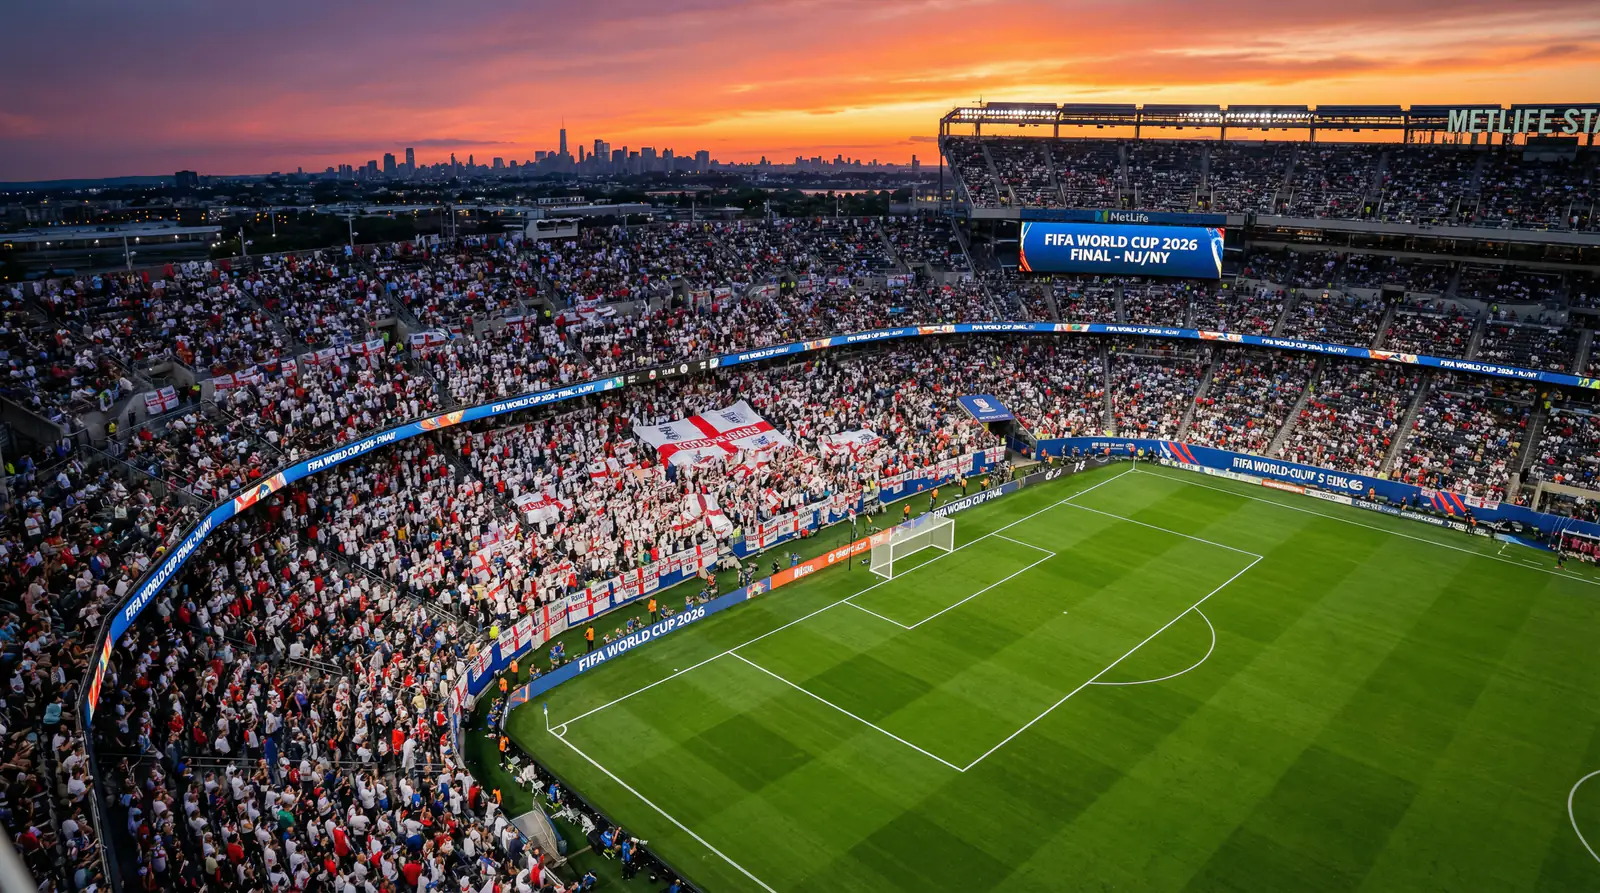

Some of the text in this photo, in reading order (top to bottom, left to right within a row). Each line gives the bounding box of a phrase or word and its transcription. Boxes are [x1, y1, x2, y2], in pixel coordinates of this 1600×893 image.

[1448, 110, 1555, 134] METLIFE
[1110, 212, 1148, 222] MetLife
[1044, 234, 1198, 250] FIFA WORLD CUP 2026
[1070, 249, 1111, 262] FINAL
[1124, 250, 1170, 265] NJ/NY
[1456, 362, 1480, 370] WORLD
[506, 398, 528, 409] WORLD
[529, 396, 541, 404] CUP
[308, 459, 324, 472] FIFA
[324, 450, 348, 465] WORLD
[348, 445, 360, 456] CUP
[948, 499, 971, 514] WORLD
[973, 494, 985, 505] CUP
[986, 488, 1003, 500] FINAL
[125, 597, 142, 621] FIFA
[141, 571, 165, 603] WORLD
[164, 556, 177, 576] CUP
[176, 541, 194, 563] FINAL
[579, 606, 705, 671] FIFA WORLD CUP 2026
